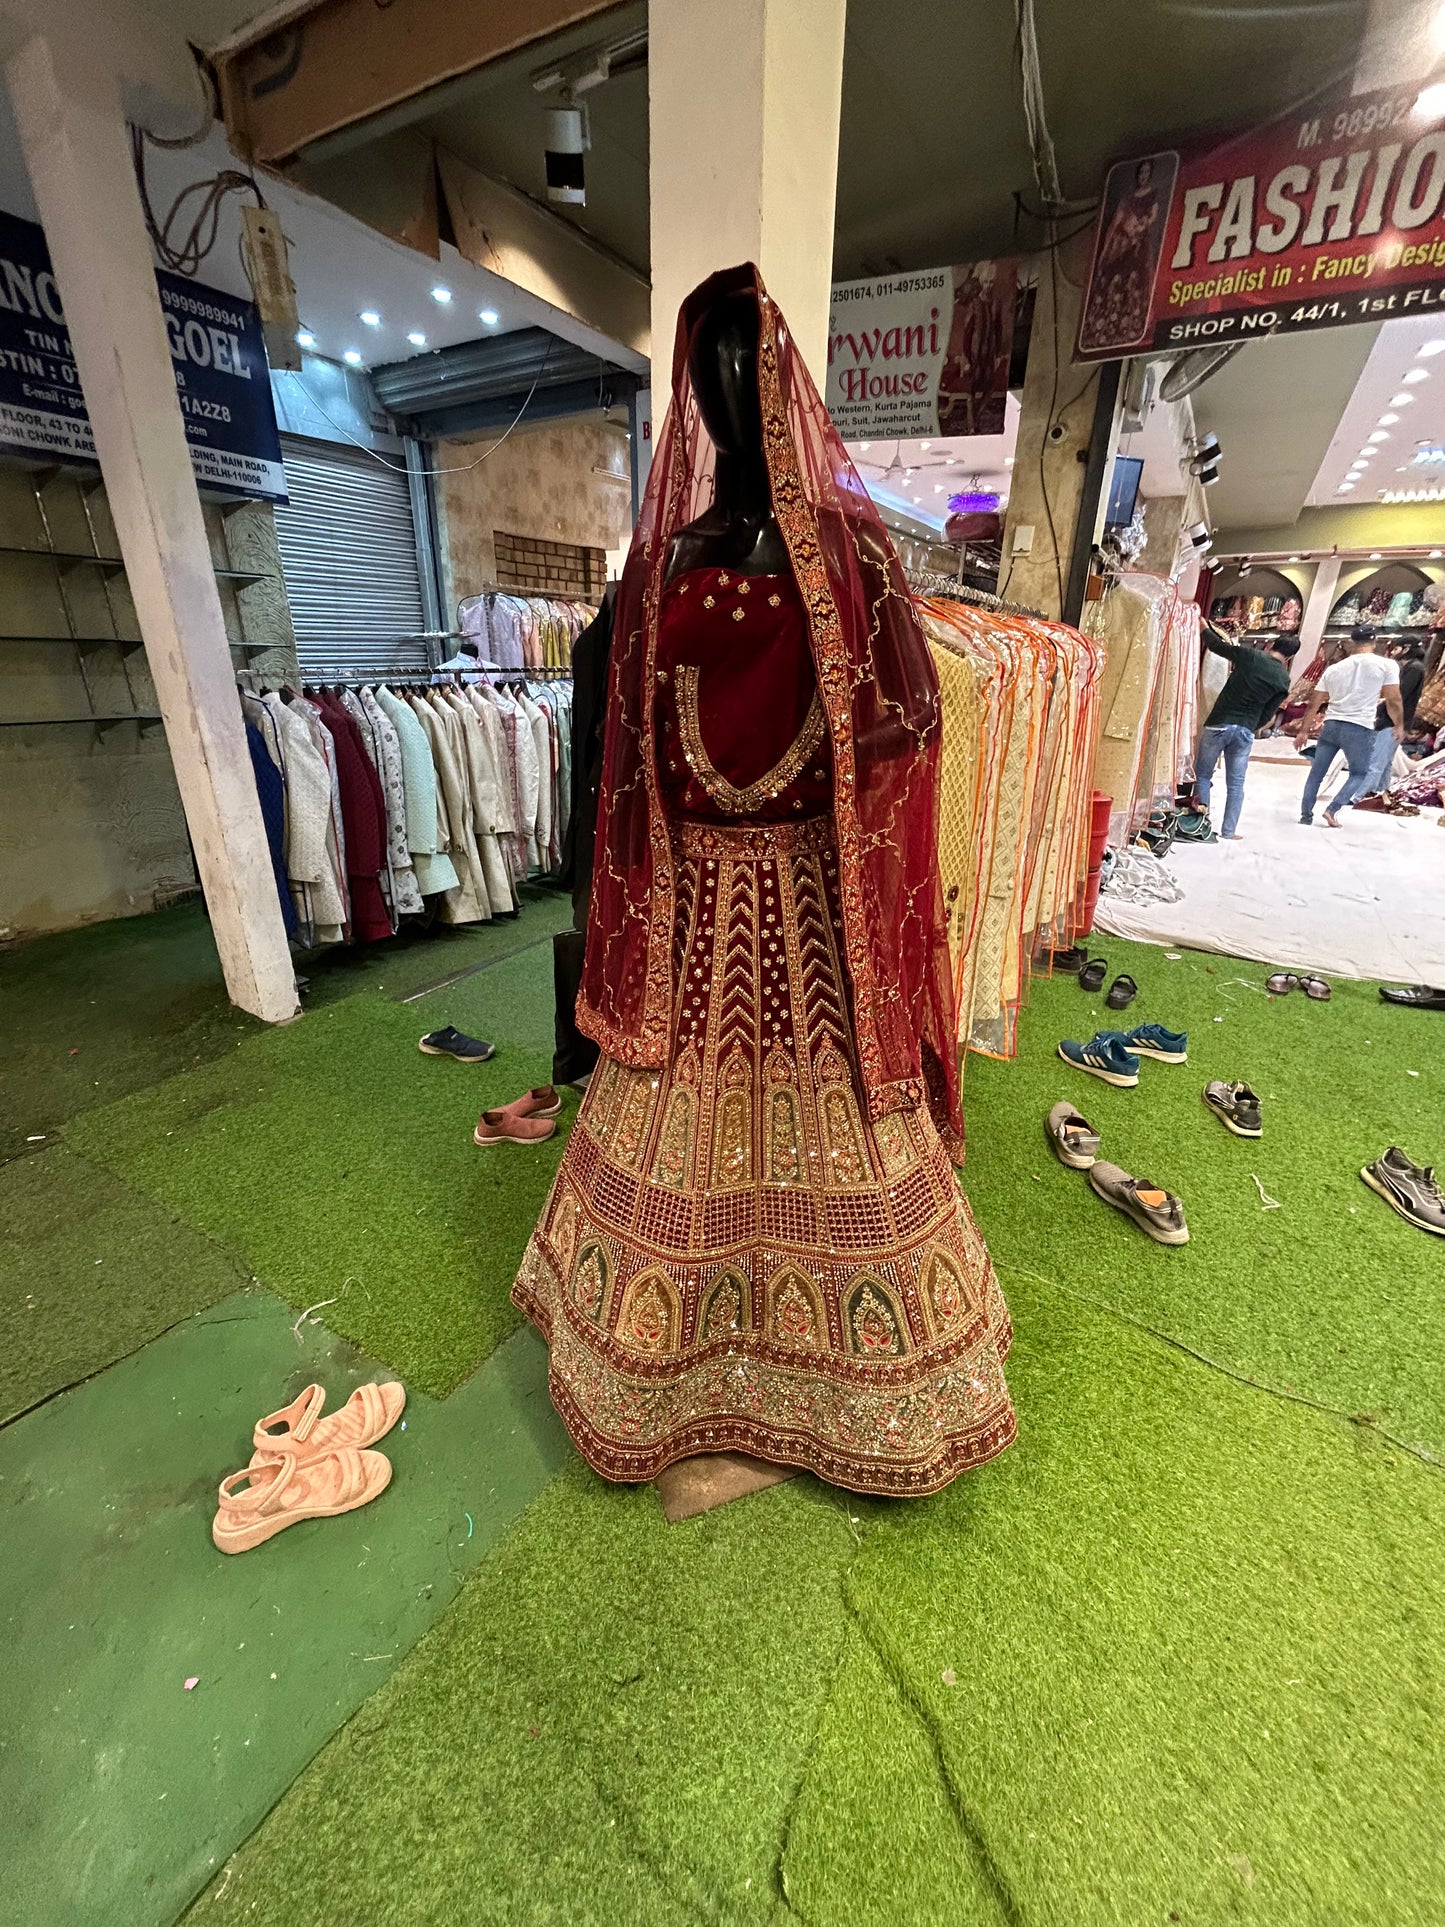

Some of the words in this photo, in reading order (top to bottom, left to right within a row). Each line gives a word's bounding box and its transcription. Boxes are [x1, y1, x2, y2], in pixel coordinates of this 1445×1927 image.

[1297, 119, 1323, 150] M.
[1171, 131, 1445, 270] FASHIO
[831, 286, 875, 304] 2501674,
[876, 274, 945, 297] 011-49753365
[1169, 268, 1266, 308] Specialist
[1270, 264, 1292, 287] in
[1311, 252, 1380, 279] Fancy
[1169, 317, 1235, 341] SHOP
[1240, 310, 1282, 330] NO.
[1291, 302, 1347, 321] 44/1,
[1358, 295, 1397, 313] 1st
[24, 329, 60, 353] TIN
[163, 312, 252, 380] GOEL
[828, 306, 941, 367] rwani
[61, 364, 78, 384] 0
[839, 367, 929, 402] House
[22, 383, 60, 403] E-mail
[837, 404, 873, 415] Western,
[875, 402, 898, 412] Kurta
[900, 400, 932, 411] Pajama
[851, 416, 870, 426] Suit,
[872, 413, 921, 425] Jawaharcut
[1, 408, 46, 429] FLOOR,
[65, 421, 81, 434] TO
[860, 428, 885, 438] Chandni
[911, 425, 934, 435] Delhi-6
[27, 429, 72, 448] CHOWK
[205, 465, 262, 486] DELHI-110006
[220, 455, 243, 469] MAIN
[245, 460, 270, 476] ROAD,
